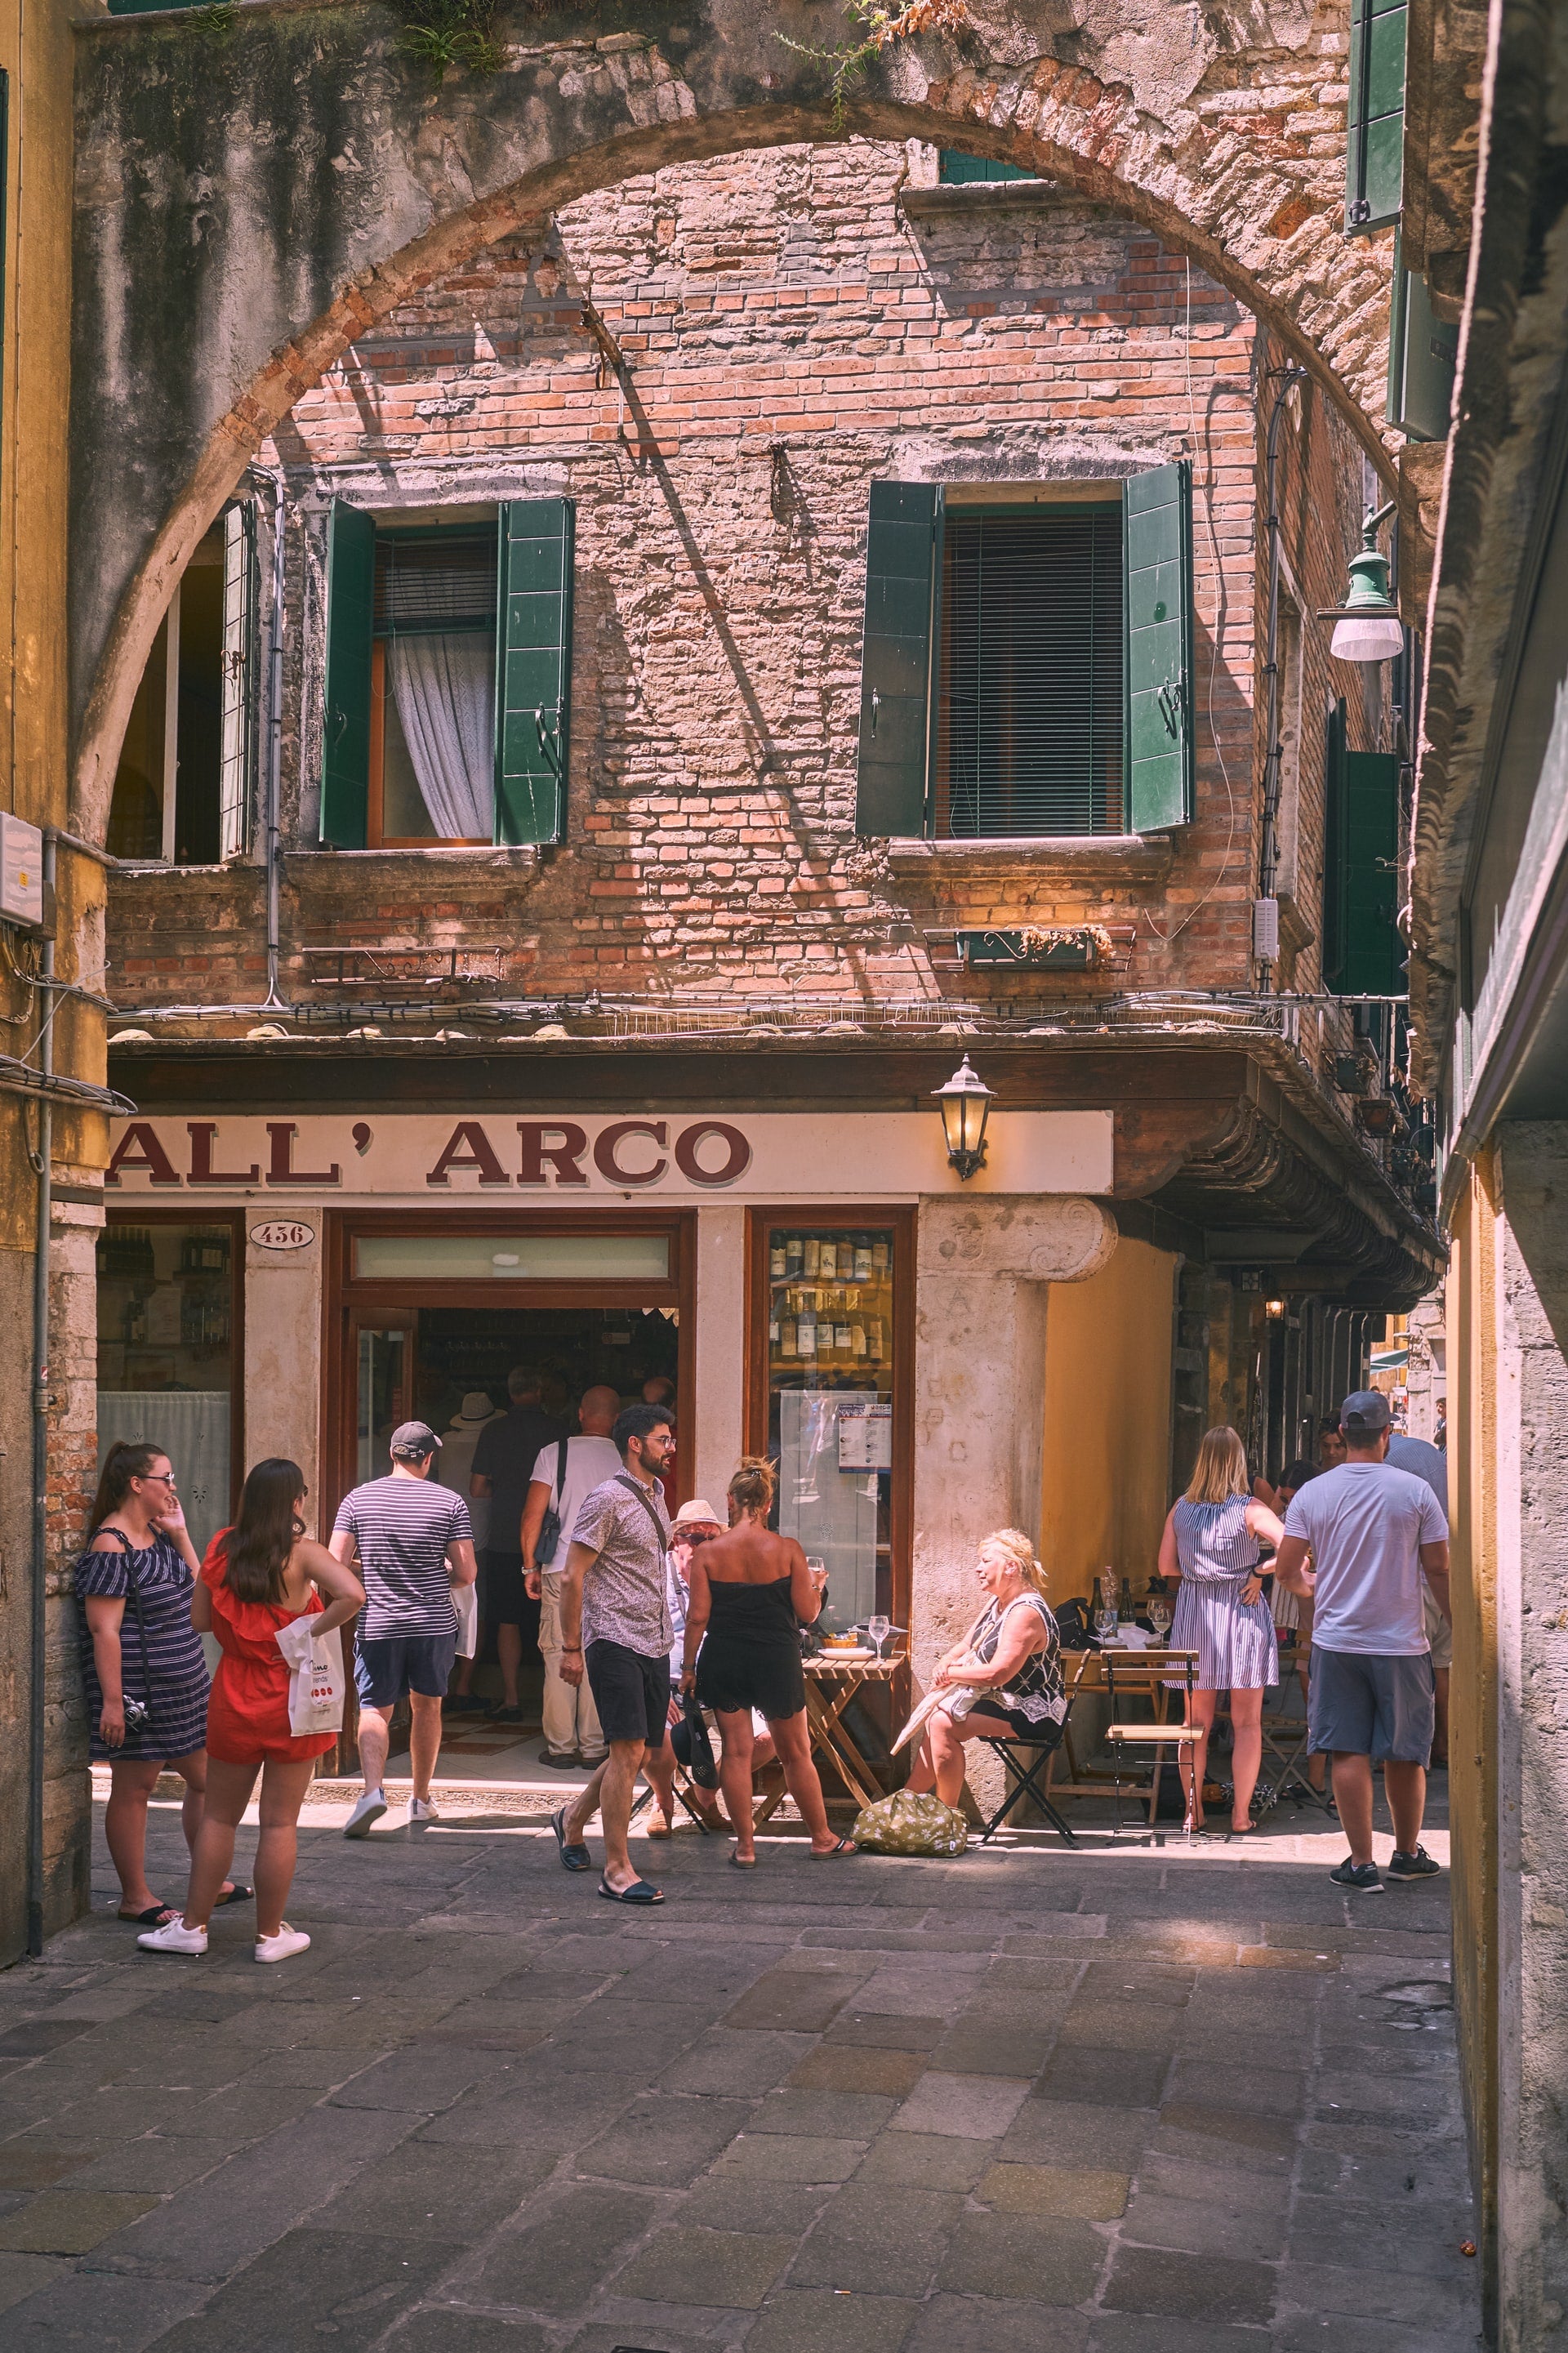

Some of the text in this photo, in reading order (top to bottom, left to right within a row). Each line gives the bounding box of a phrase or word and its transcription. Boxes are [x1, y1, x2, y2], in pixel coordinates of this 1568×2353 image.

[104, 1121, 751, 1185] ALL' ARCO
[259, 1226, 304, 1243] 436
